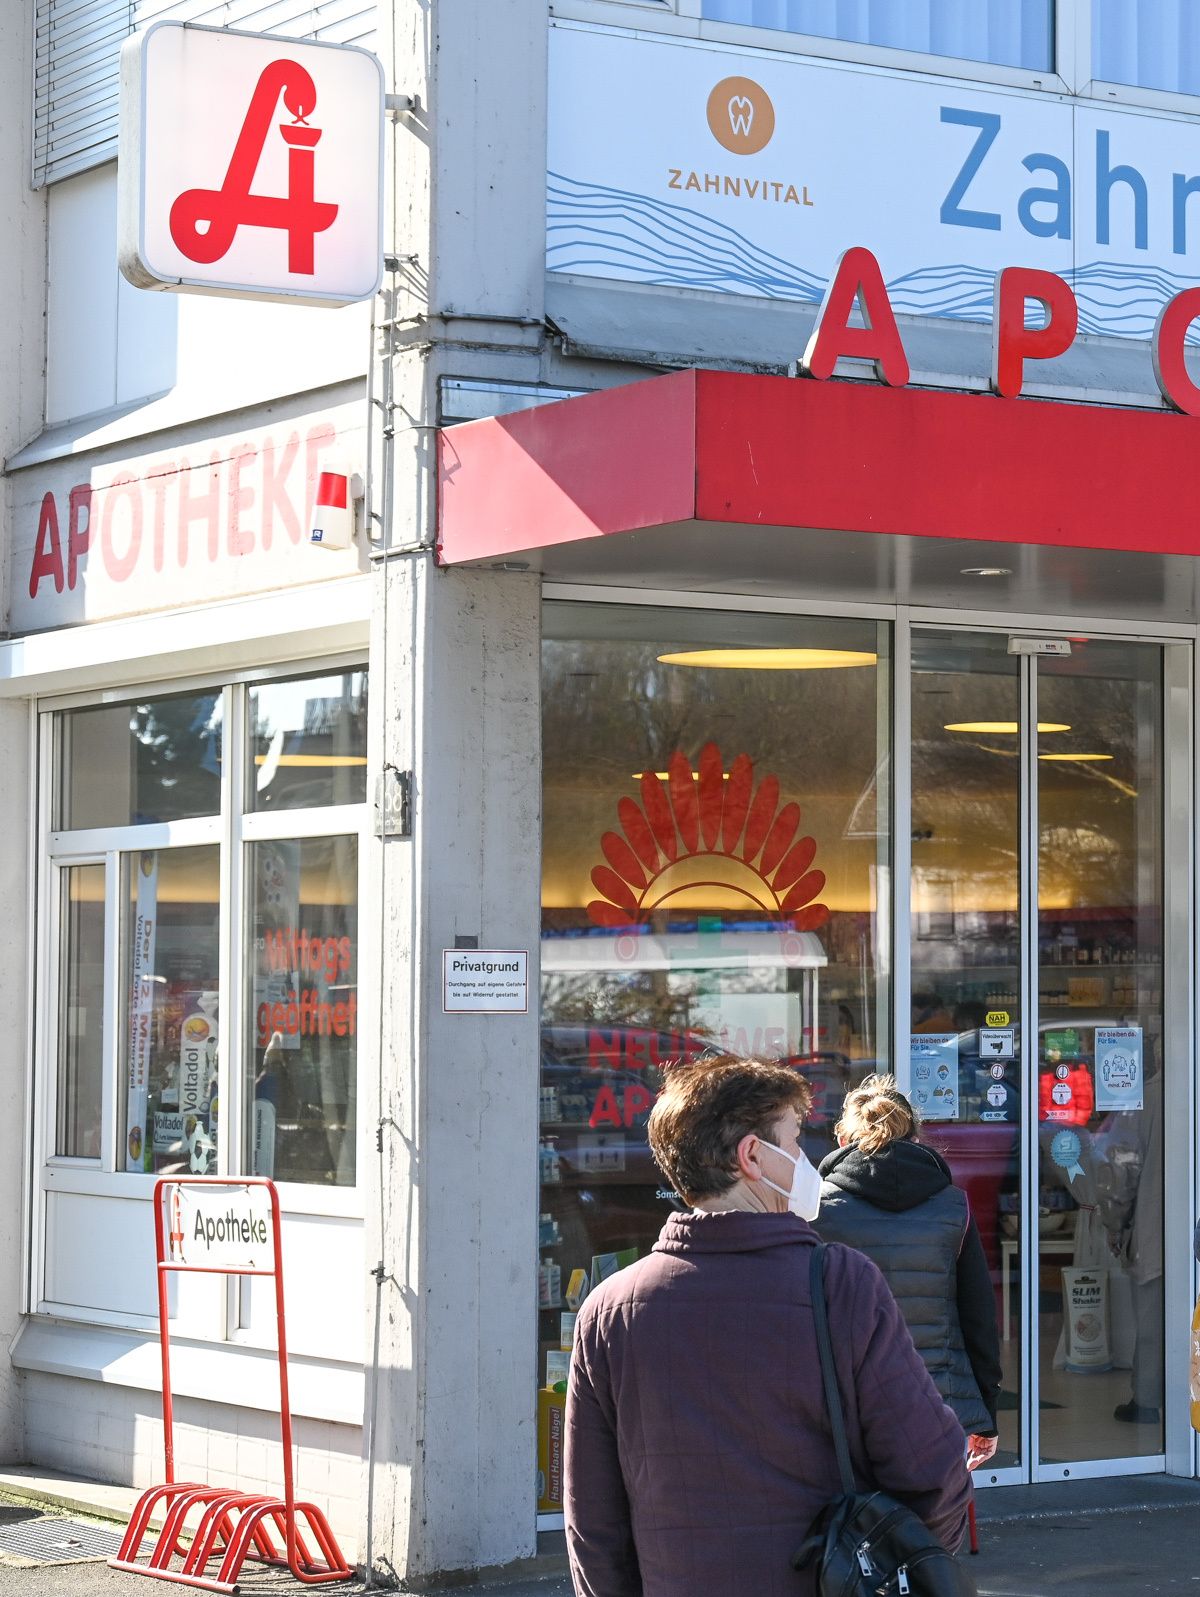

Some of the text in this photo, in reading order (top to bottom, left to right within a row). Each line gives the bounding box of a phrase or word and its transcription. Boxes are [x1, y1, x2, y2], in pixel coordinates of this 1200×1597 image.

[668, 168, 814, 206] ZAHNVITAL
[135, 914, 143, 970] Voltadol
[142, 920, 152, 963] Der
[264, 927, 352, 983] Mittags
[453, 960, 519, 974] Privatgrund
[256, 989, 357, 1049] geöffnet
[137, 1014, 149, 1085] Mann
[183, 1048, 199, 1112] Voltadol
[154, 1114, 184, 1131] Voltadol
[194, 1208, 267, 1251] Apotheke
[1072, 1286, 1101, 1296] SLIM
[1072, 1296, 1101, 1305] Shake
[551, 1408, 561, 1501] Haut Haare Nägel
